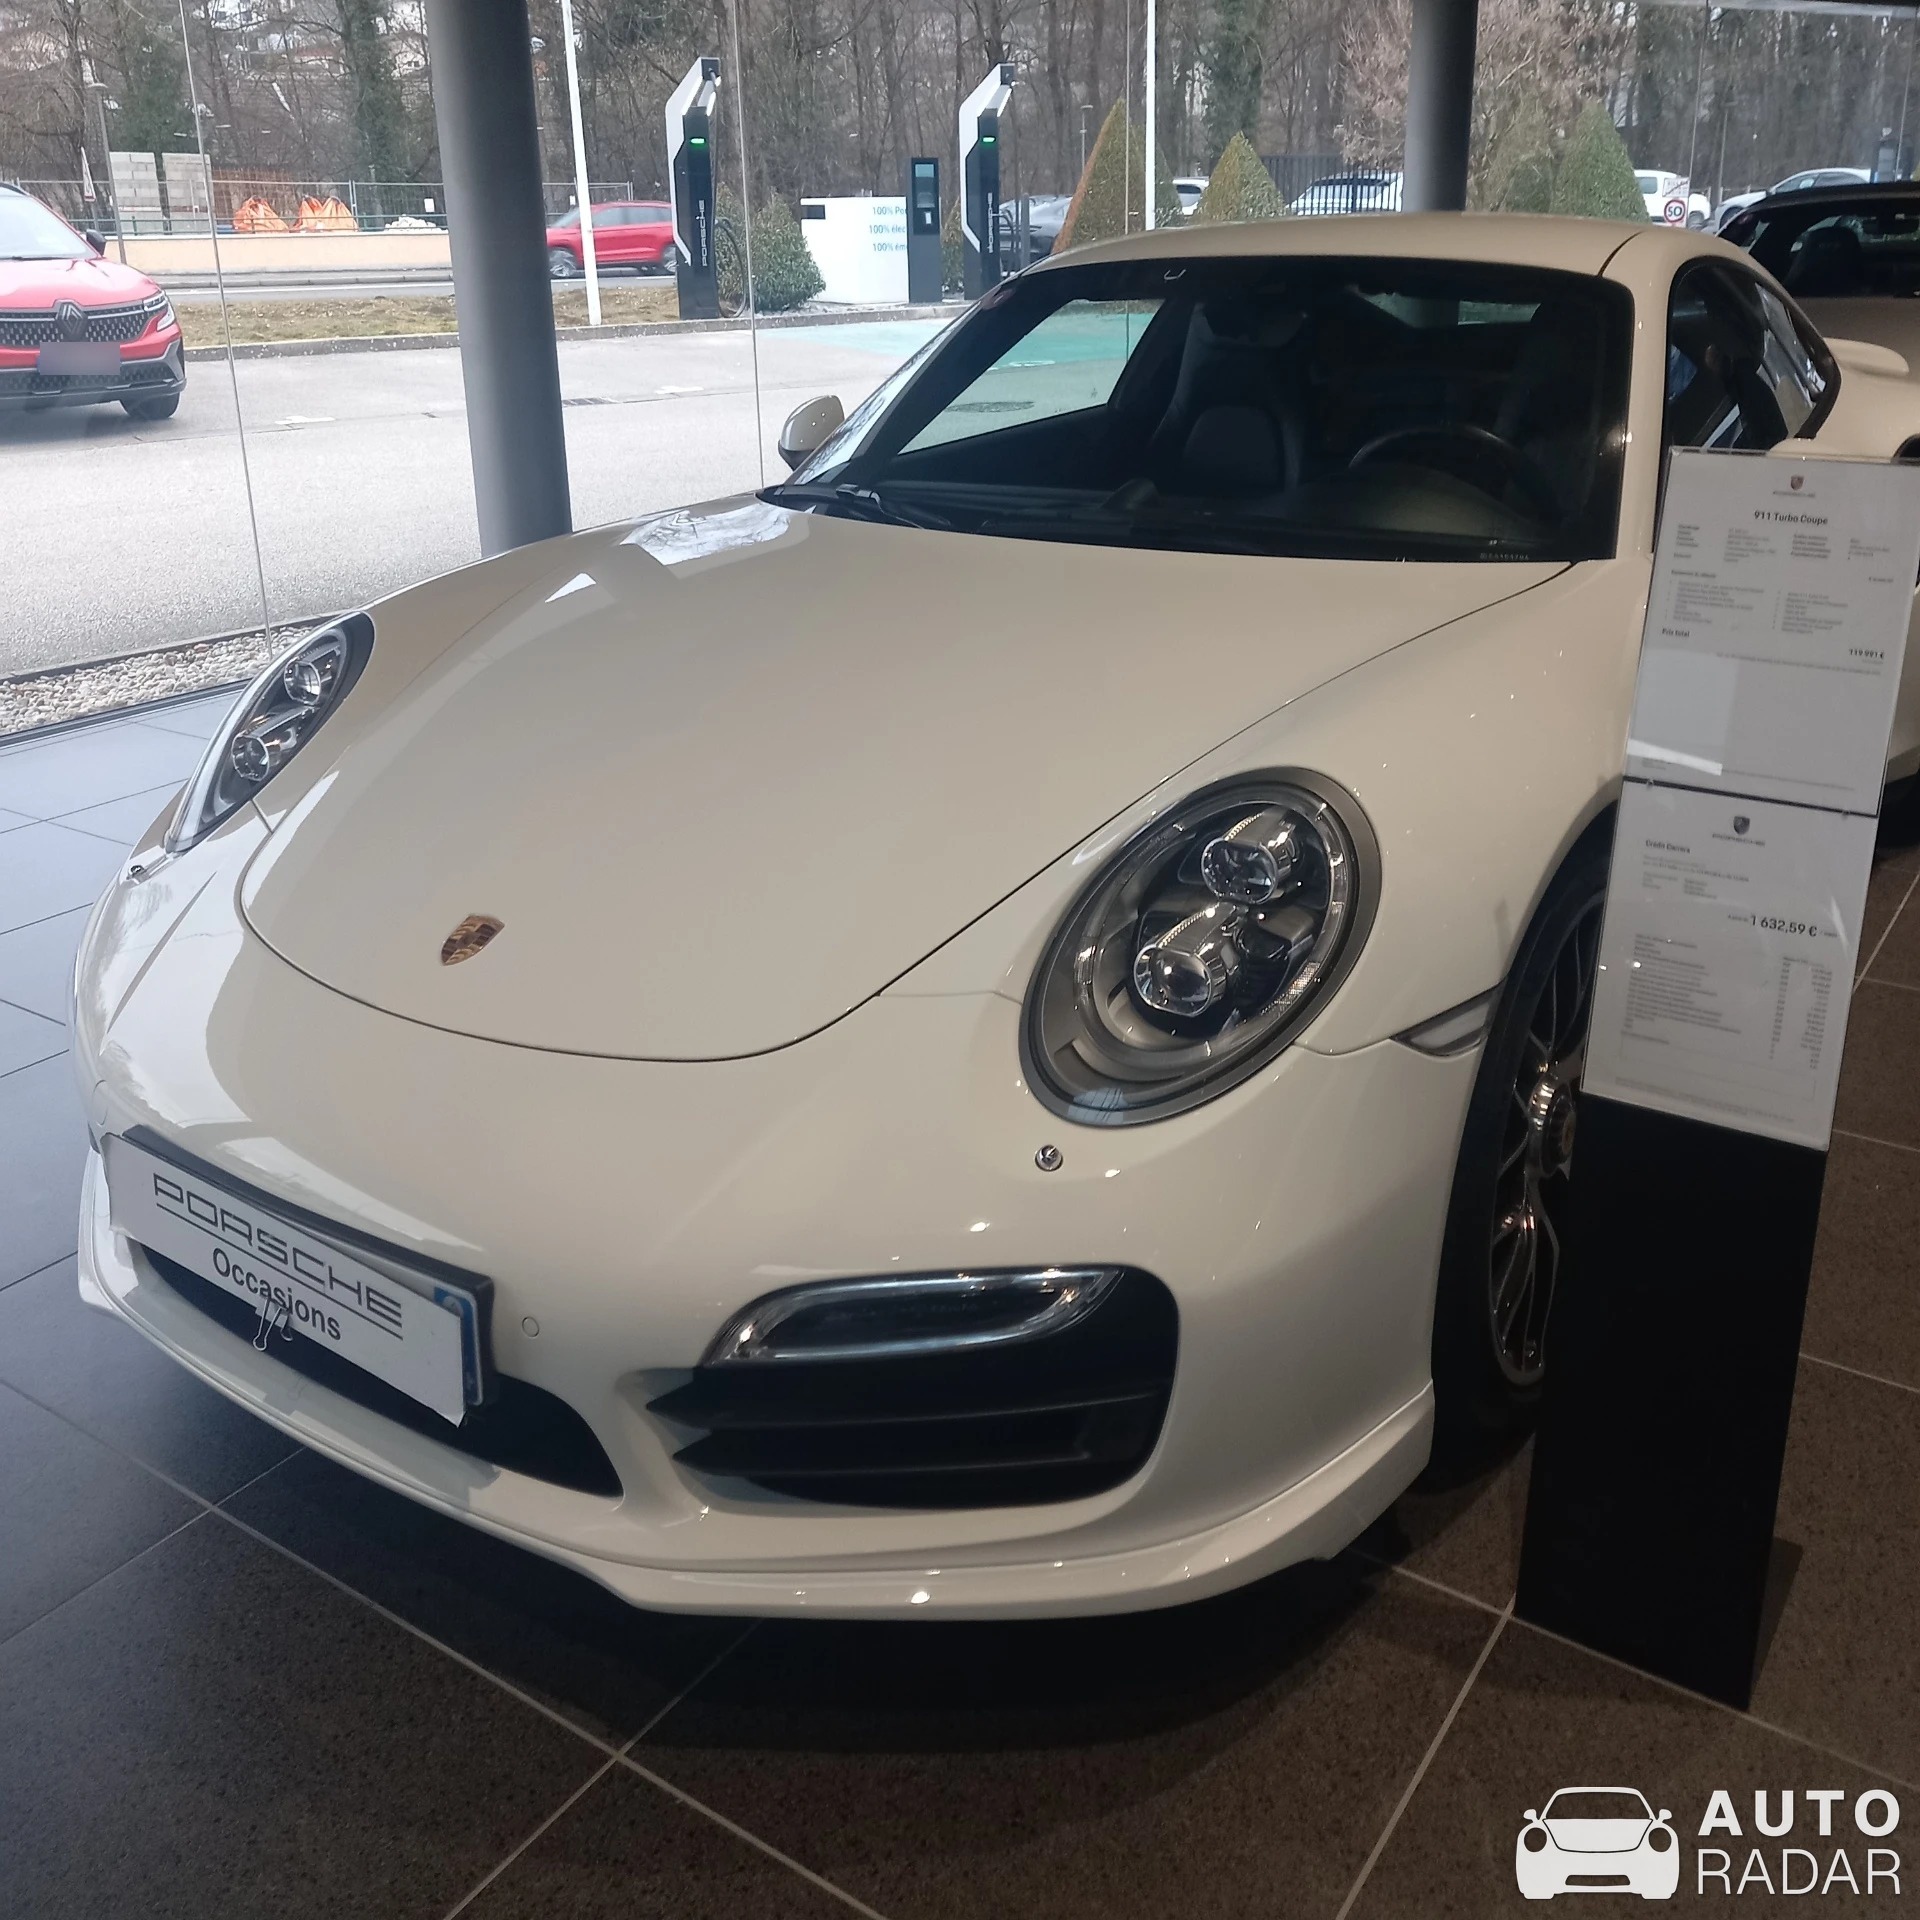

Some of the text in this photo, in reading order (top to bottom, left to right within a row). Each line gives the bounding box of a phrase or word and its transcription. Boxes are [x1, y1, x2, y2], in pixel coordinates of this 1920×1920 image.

[873, 206, 893, 215] 100%
[1668, 206, 1682, 217] 50
[698, 200, 707, 266] PORSCHE
[869, 224, 890, 234] 100%
[873, 243, 893, 252] 100%
[1754, 510, 1828, 526] 911 Turbo Coupe
[1673, 629, 1690, 638] total
[1750, 914, 1757, 926] 1
[1760, 916, 1806, 935] 632,59
[1808, 925, 1818, 937] €
[153, 1173, 402, 1329] PORSCHE
[213, 1247, 341, 1340] Occasions
